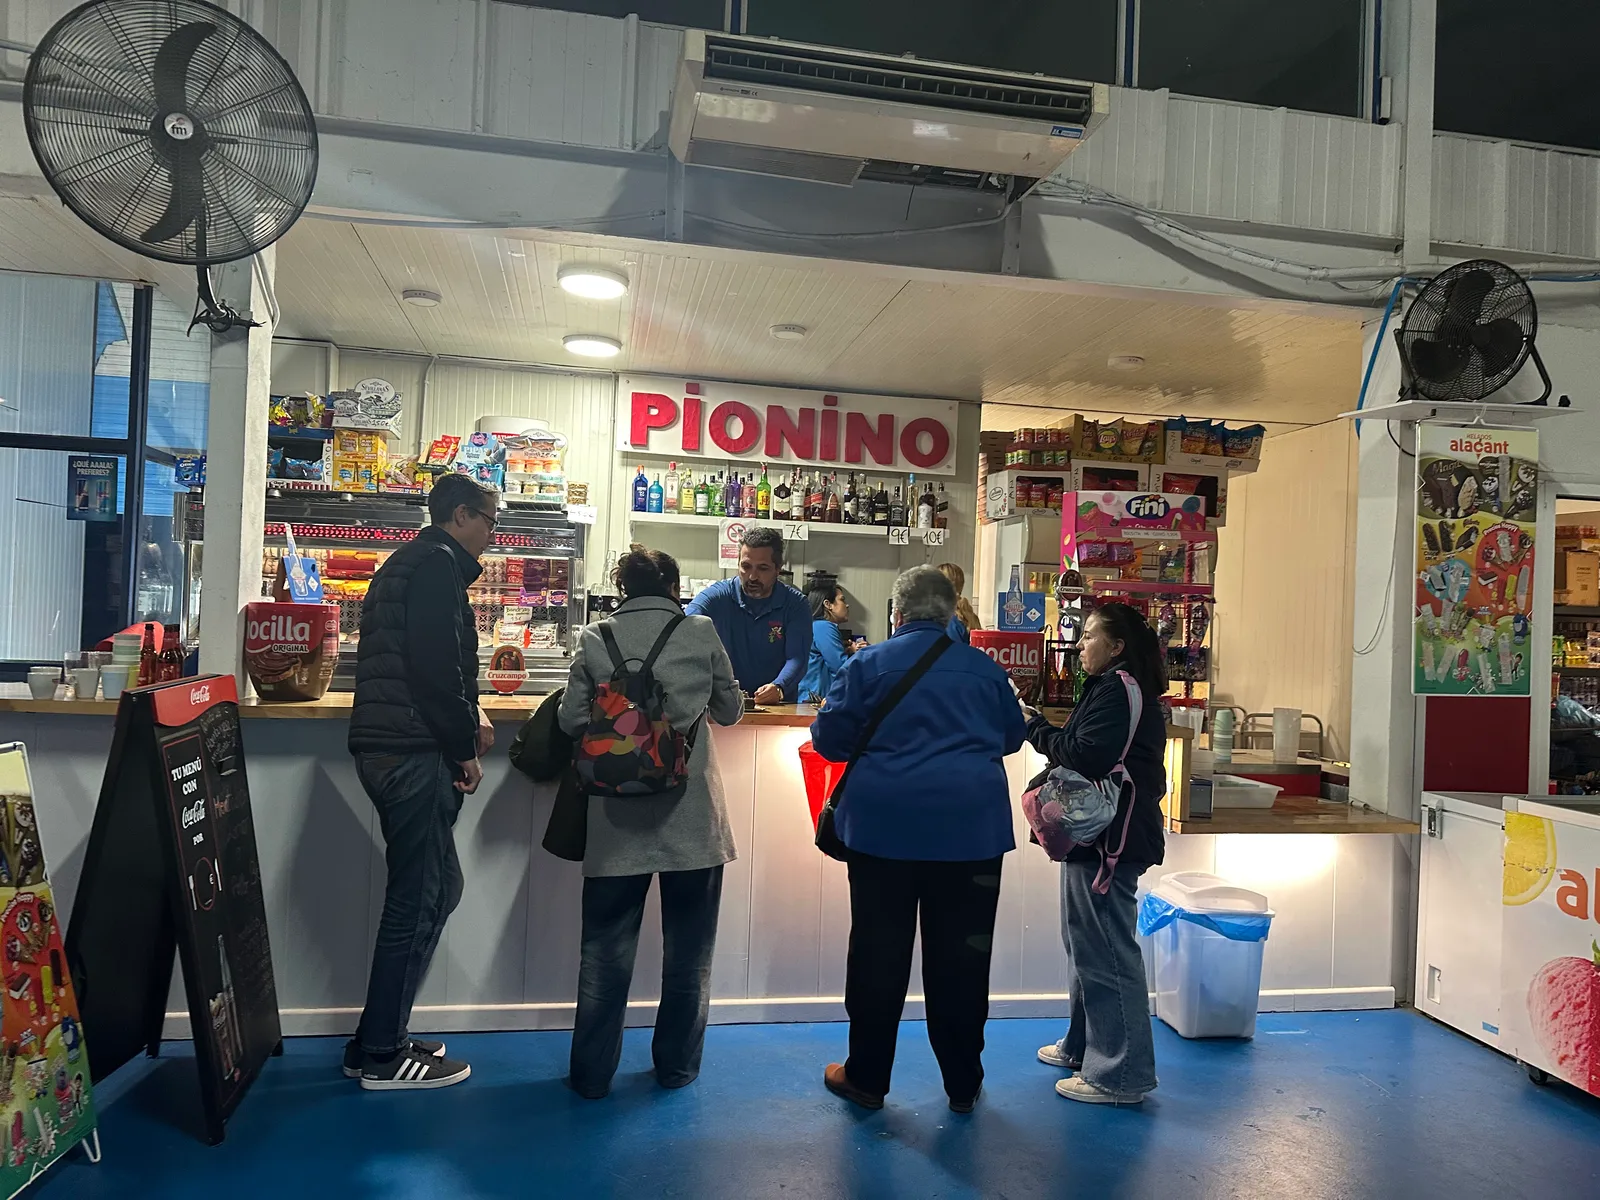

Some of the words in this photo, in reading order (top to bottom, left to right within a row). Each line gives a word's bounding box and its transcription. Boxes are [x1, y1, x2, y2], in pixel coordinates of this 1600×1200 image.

[785, 525, 803, 539] 7€
[891, 528, 908, 544] 9€
[923, 530, 943, 544] 10€
[248, 614, 310, 642] ocilla
[272, 644, 309, 653] ORIGINAL
[487, 671, 527, 680] Cruzcampo
[171, 768, 182, 782] TU
[182, 757, 202, 777] MENÚ
[182, 779, 197, 796] CON
[193, 833, 204, 846] POR
